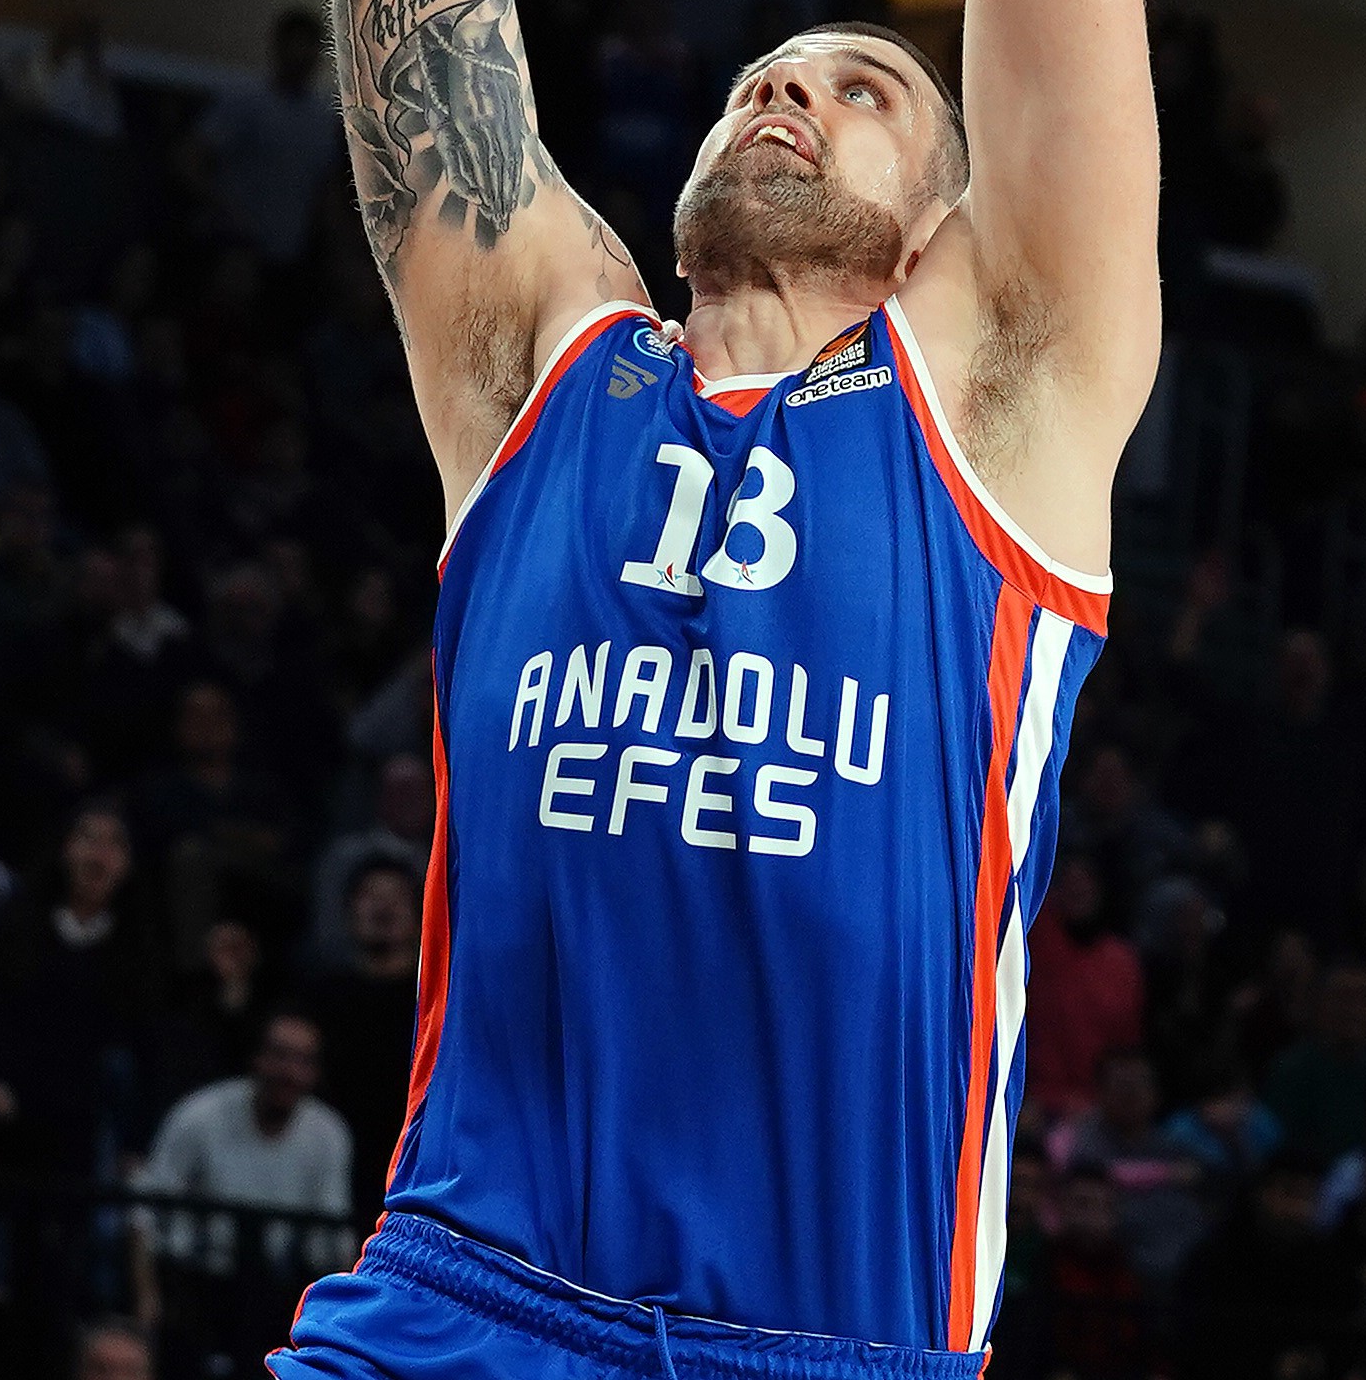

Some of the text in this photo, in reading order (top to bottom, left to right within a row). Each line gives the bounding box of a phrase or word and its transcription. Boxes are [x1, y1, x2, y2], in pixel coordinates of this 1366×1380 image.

[786, 368, 891, 406] oneteam
[508, 640, 890, 786] ANADOLU
[539, 742, 819, 858] EFES
